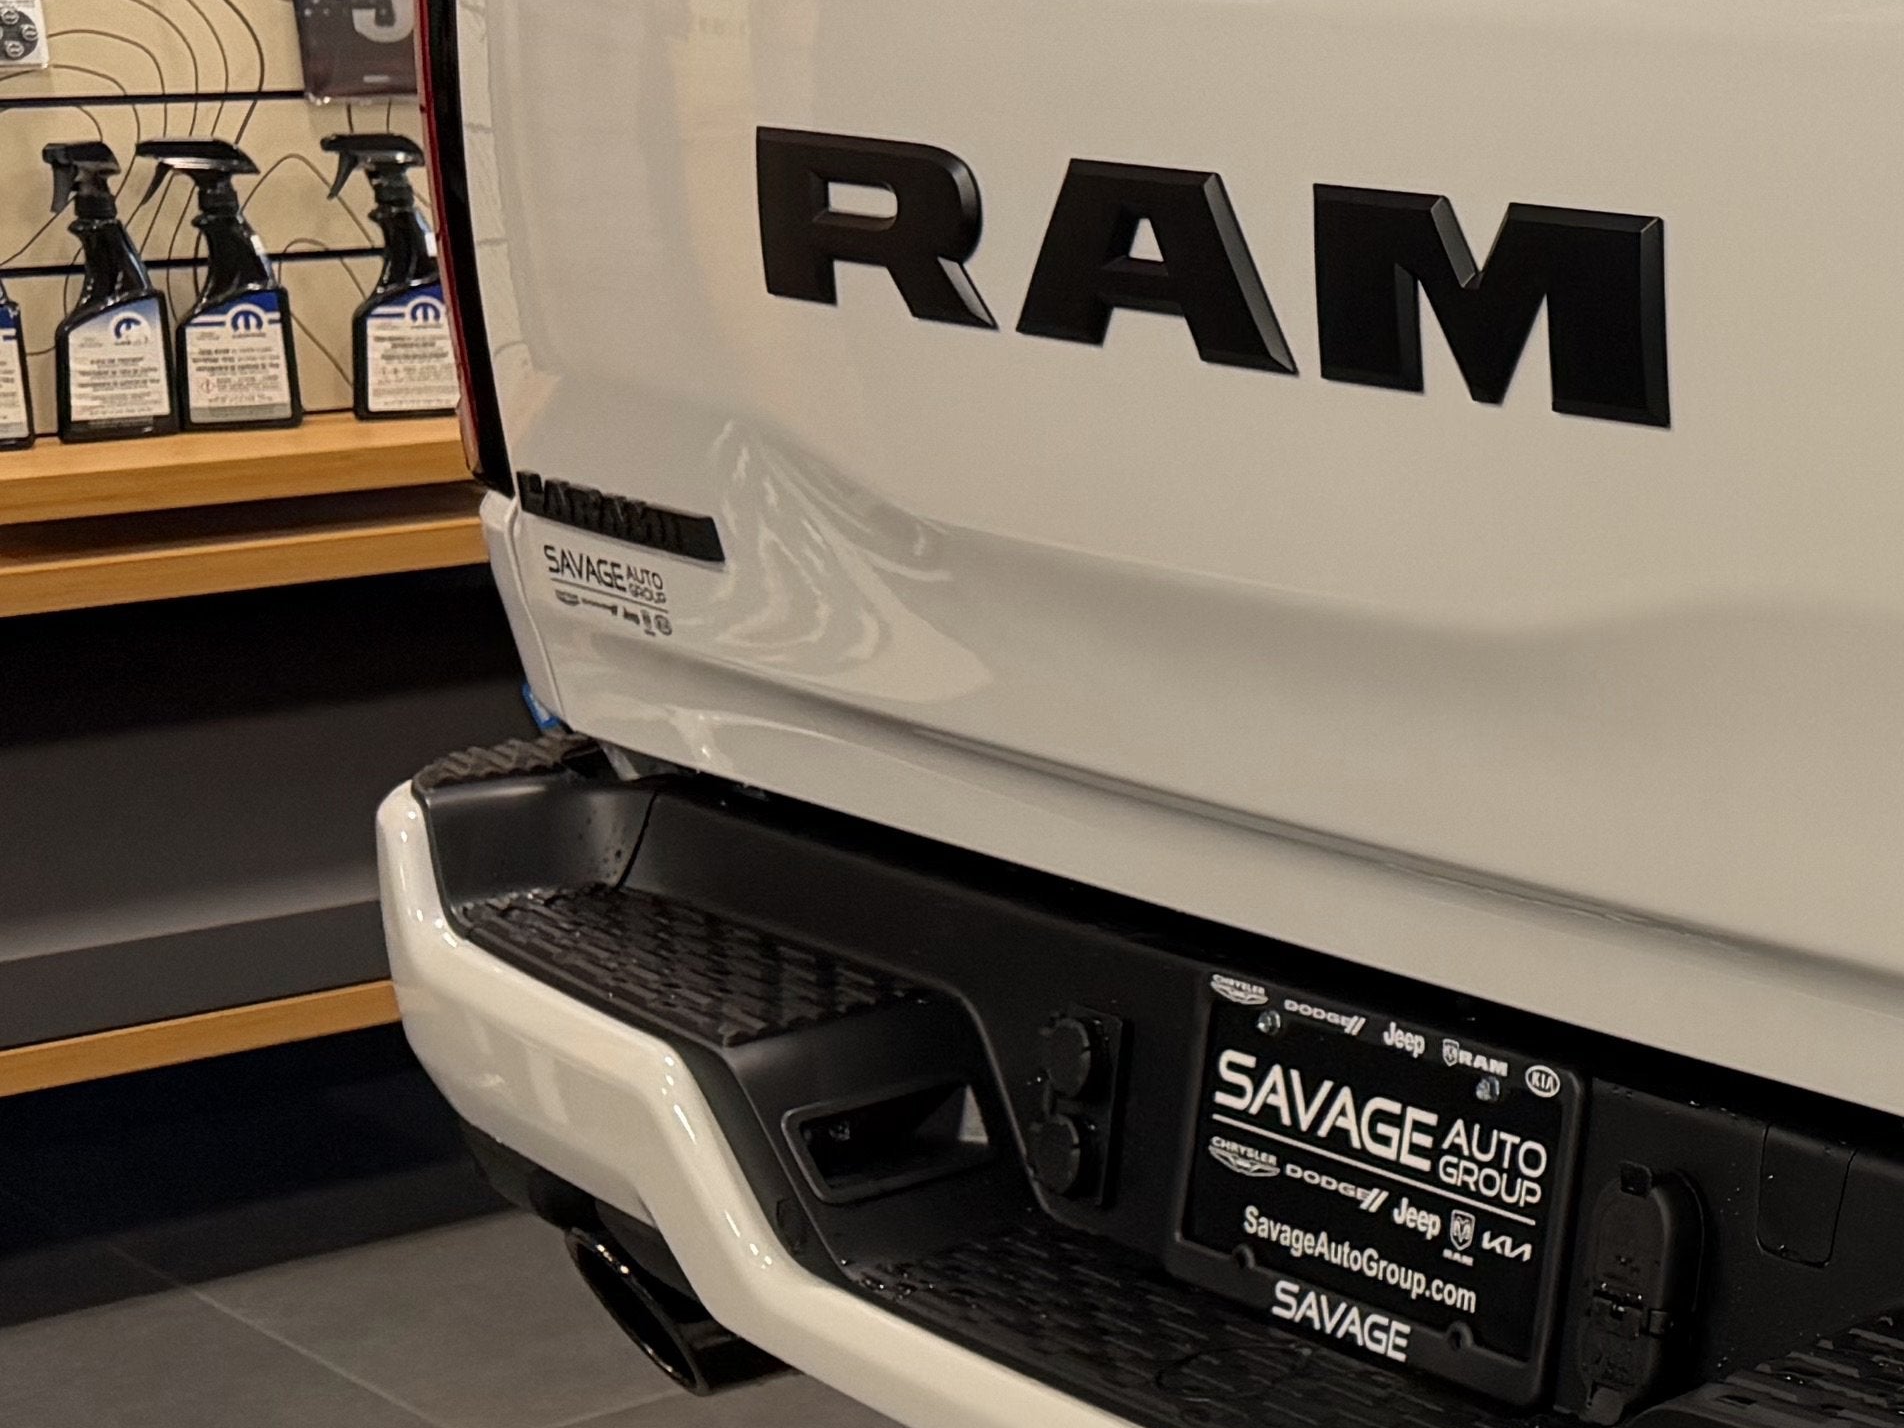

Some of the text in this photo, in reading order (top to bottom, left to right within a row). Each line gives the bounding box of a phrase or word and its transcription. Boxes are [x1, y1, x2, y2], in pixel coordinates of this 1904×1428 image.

[755, 124, 1672, 430] RAM
[543, 544, 664, 593] SAVAGE AUTO
[1283, 998, 1352, 1027] DODGE
[1382, 1021, 1426, 1059] Jeep
[1458, 1049, 1509, 1078] RAM
[1213, 1048, 1548, 1179] SAVAGE AUTO
[1210, 1135, 1278, 1165] CHRYSLER
[1285, 1162, 1370, 1200] DODGE
[1392, 1196, 1442, 1241] Jeep
[1437, 1154, 1542, 1208] GROUP
[1243, 1204, 1477, 1314] SavageAutoGroup.com
[1442, 1248, 1475, 1267] RAM
[1271, 1279, 1412, 1362] SAVAGE
